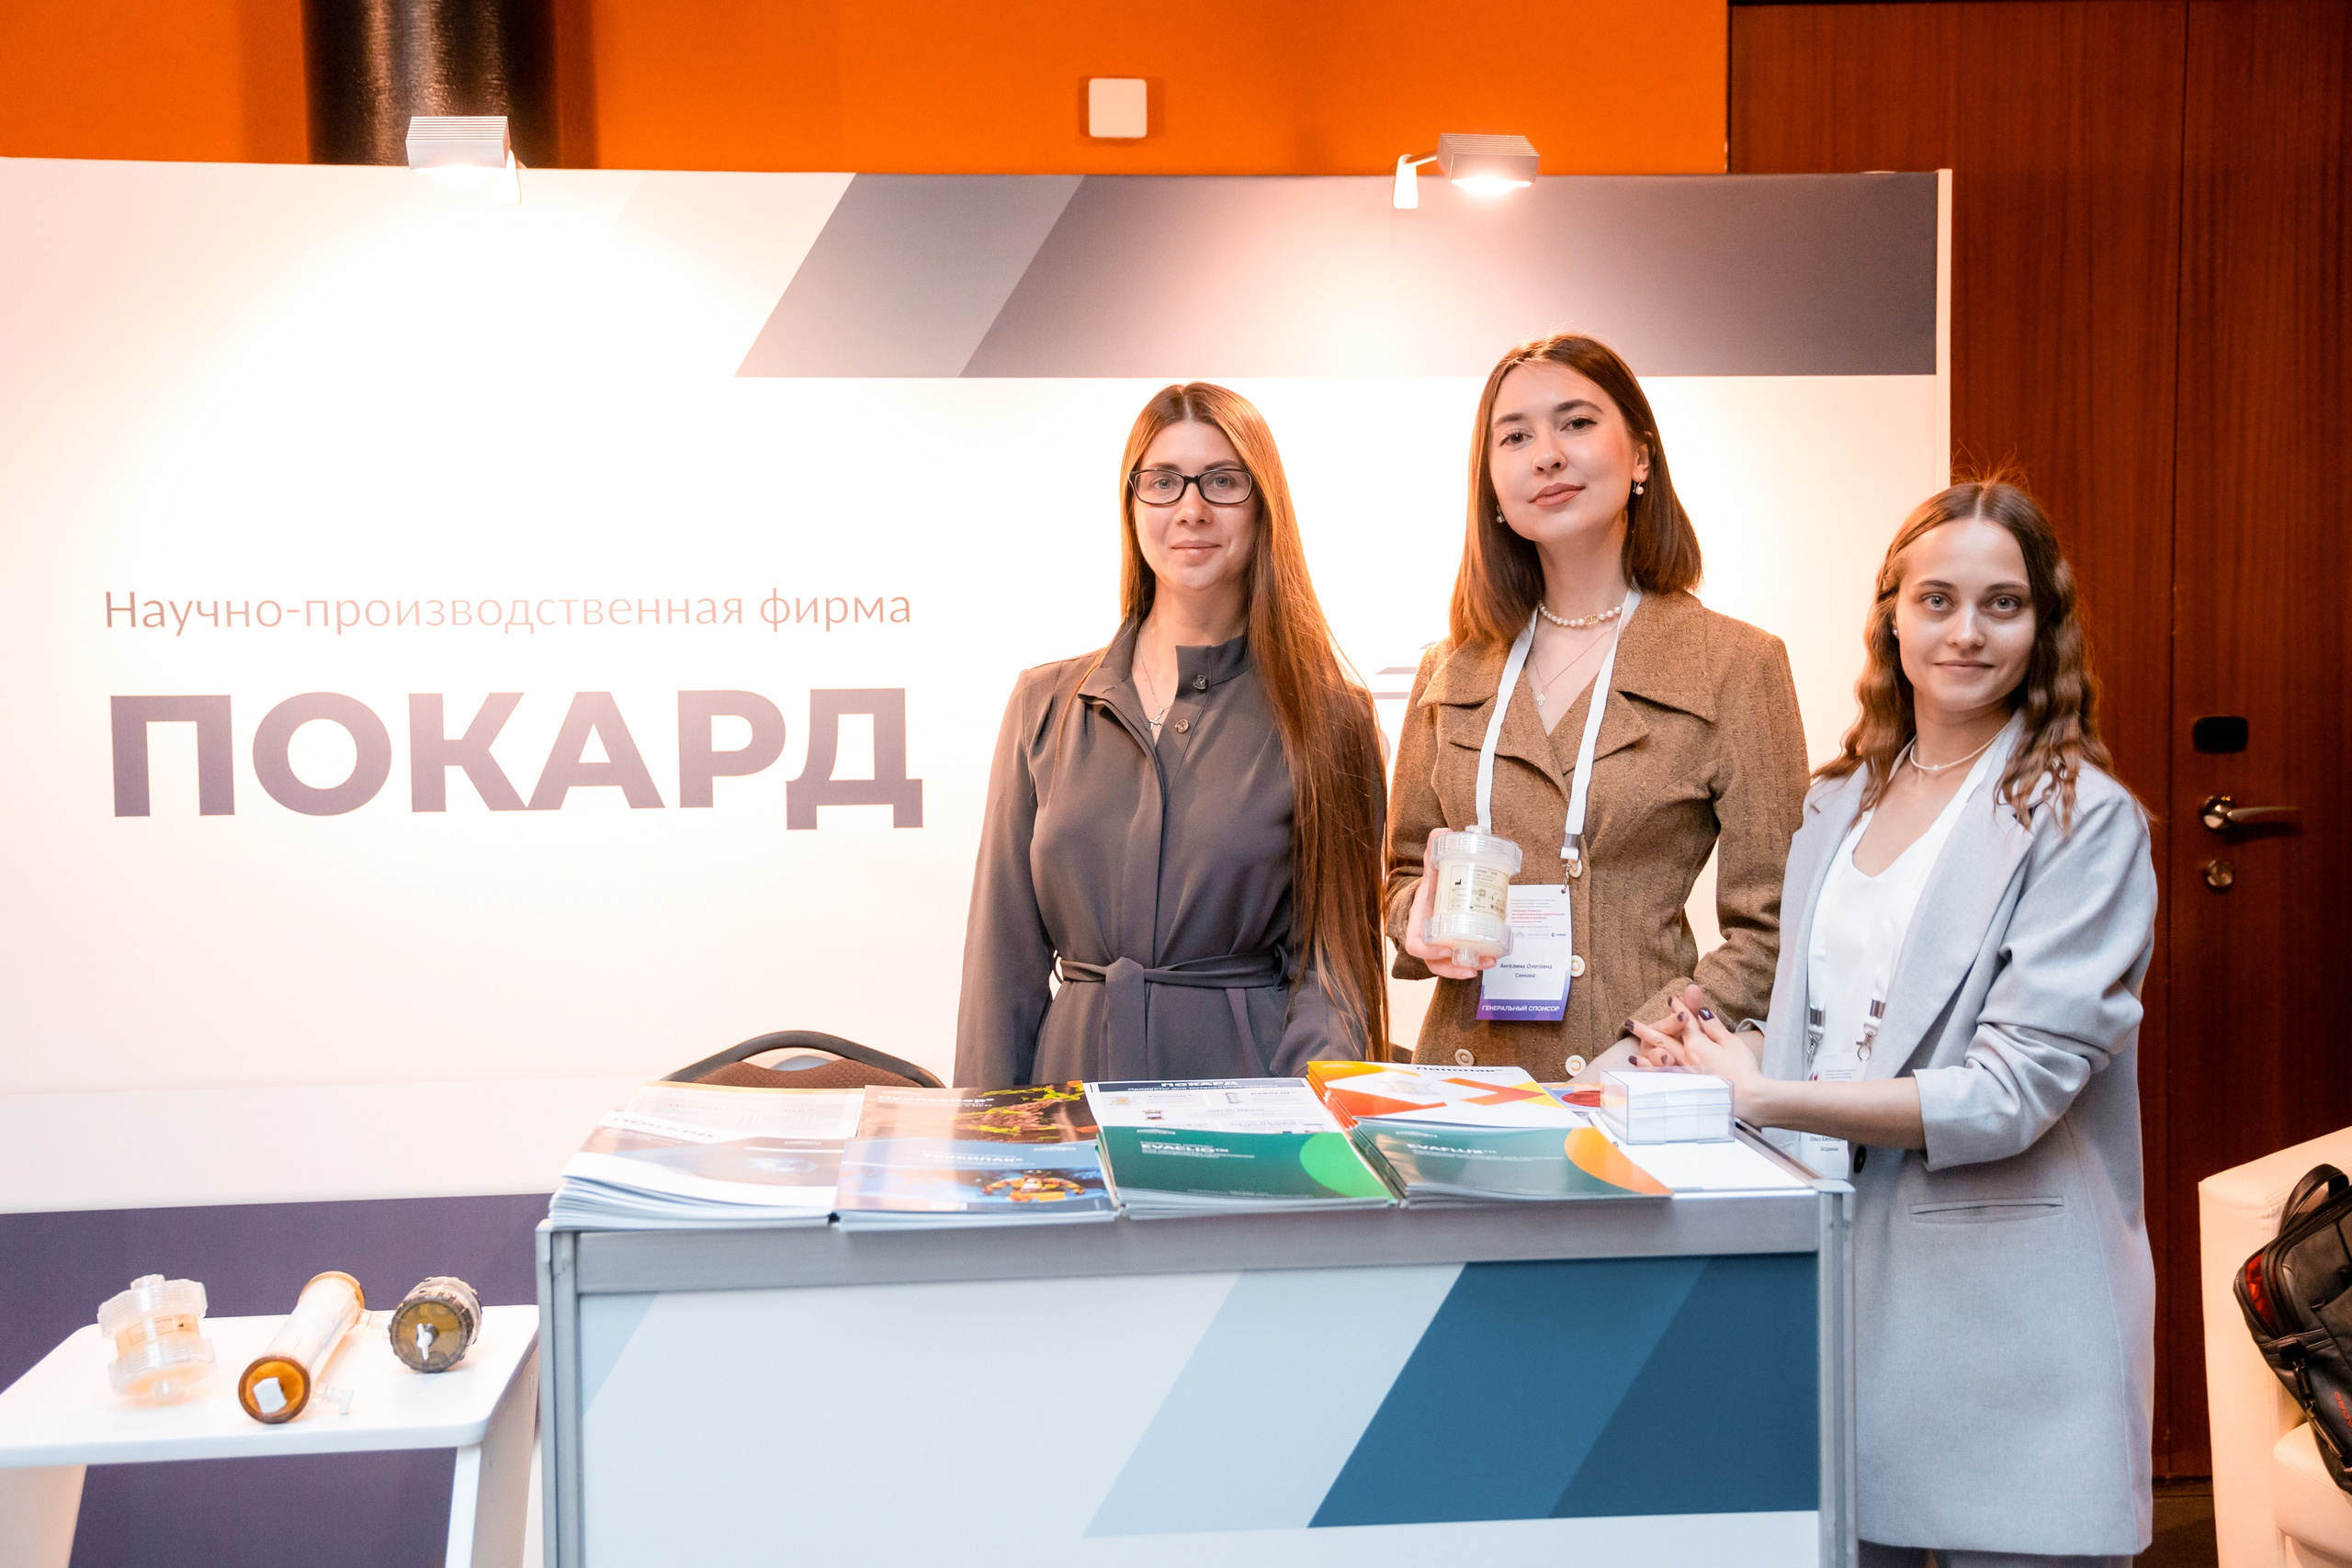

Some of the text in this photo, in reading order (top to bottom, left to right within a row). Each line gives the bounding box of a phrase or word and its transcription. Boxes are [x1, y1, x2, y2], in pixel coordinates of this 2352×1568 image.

[105, 587, 912, 636] Научно-производственная фирма
[110, 687, 924, 830] ПОКАРД
